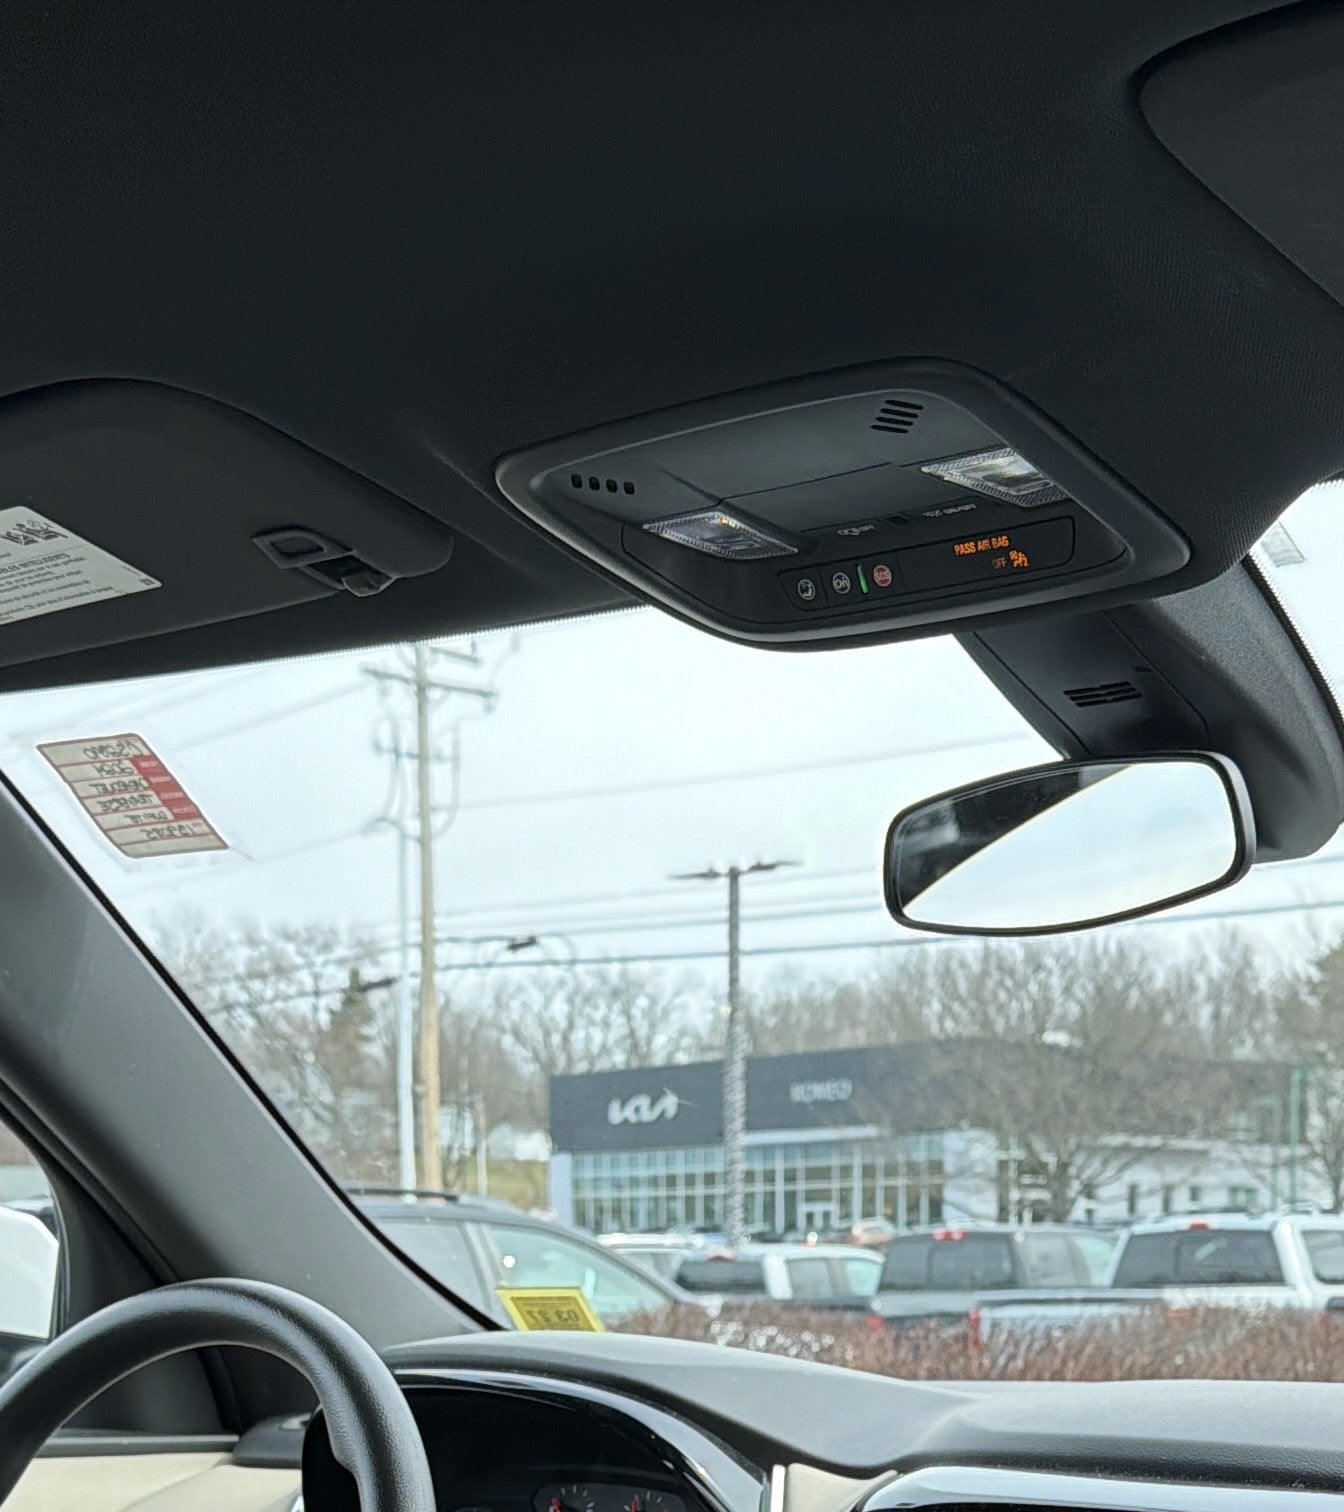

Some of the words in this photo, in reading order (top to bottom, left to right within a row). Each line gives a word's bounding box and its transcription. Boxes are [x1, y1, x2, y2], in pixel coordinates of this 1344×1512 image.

[954, 541, 977, 556] PASS
[977, 538, 992, 552] AIR
[992, 535, 1010, 549] BAG
[992, 557, 1006, 569] OFF
